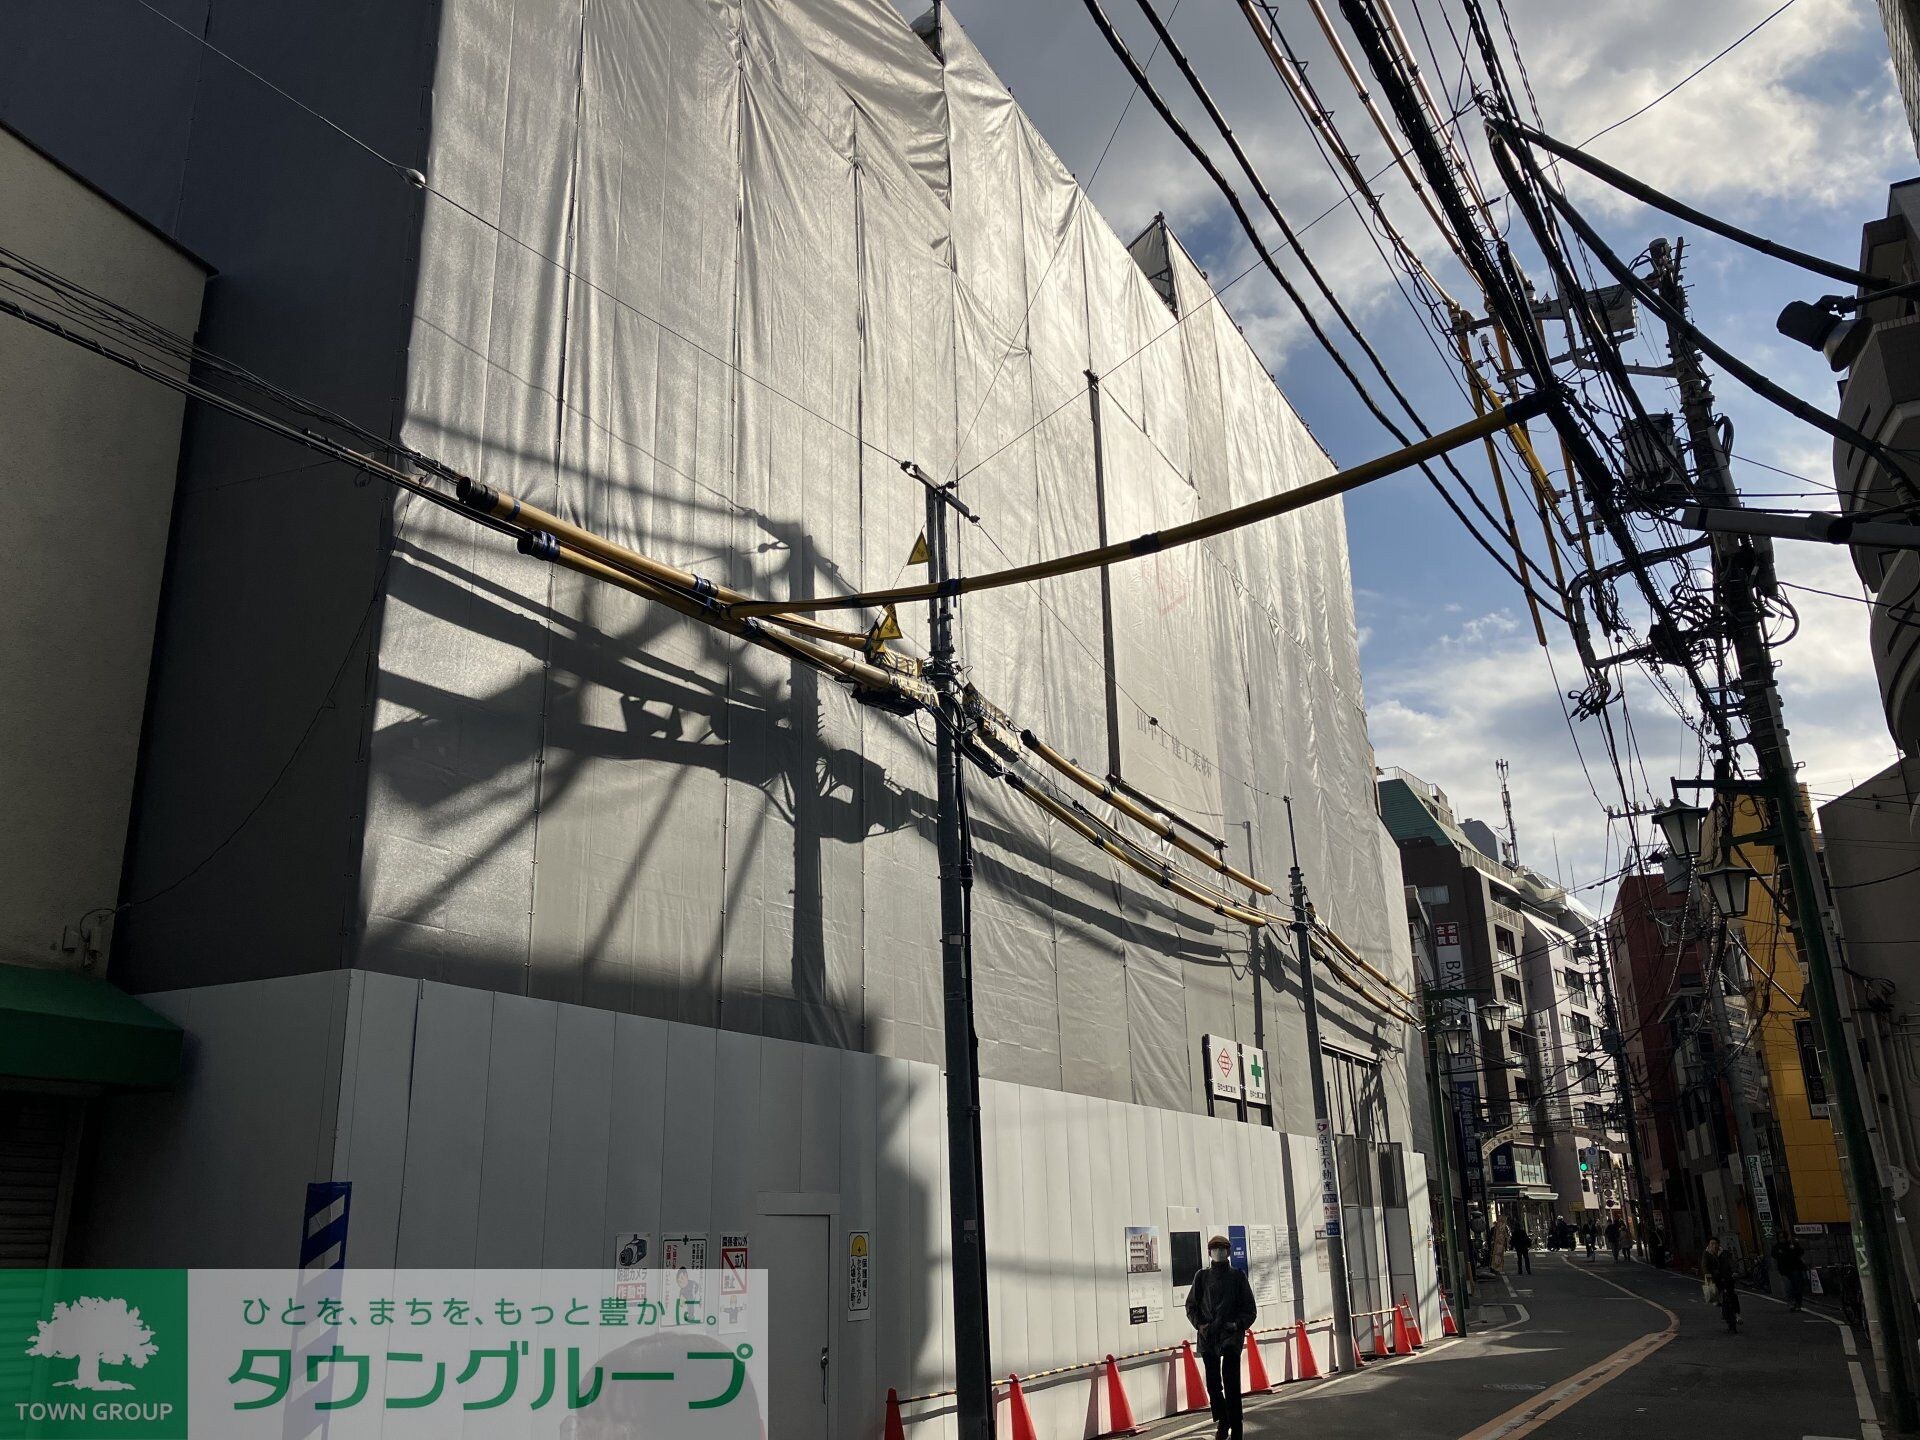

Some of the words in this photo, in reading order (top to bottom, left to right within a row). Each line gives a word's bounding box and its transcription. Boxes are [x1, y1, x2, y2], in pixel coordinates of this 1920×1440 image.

[1318, 1133, 1334, 1192] 京王不動産
[721, 1236, 748, 1247] 関係者以外
[616, 1267, 648, 1282] 防犯カメラ
[617, 1285, 646, 1299] 作動中
